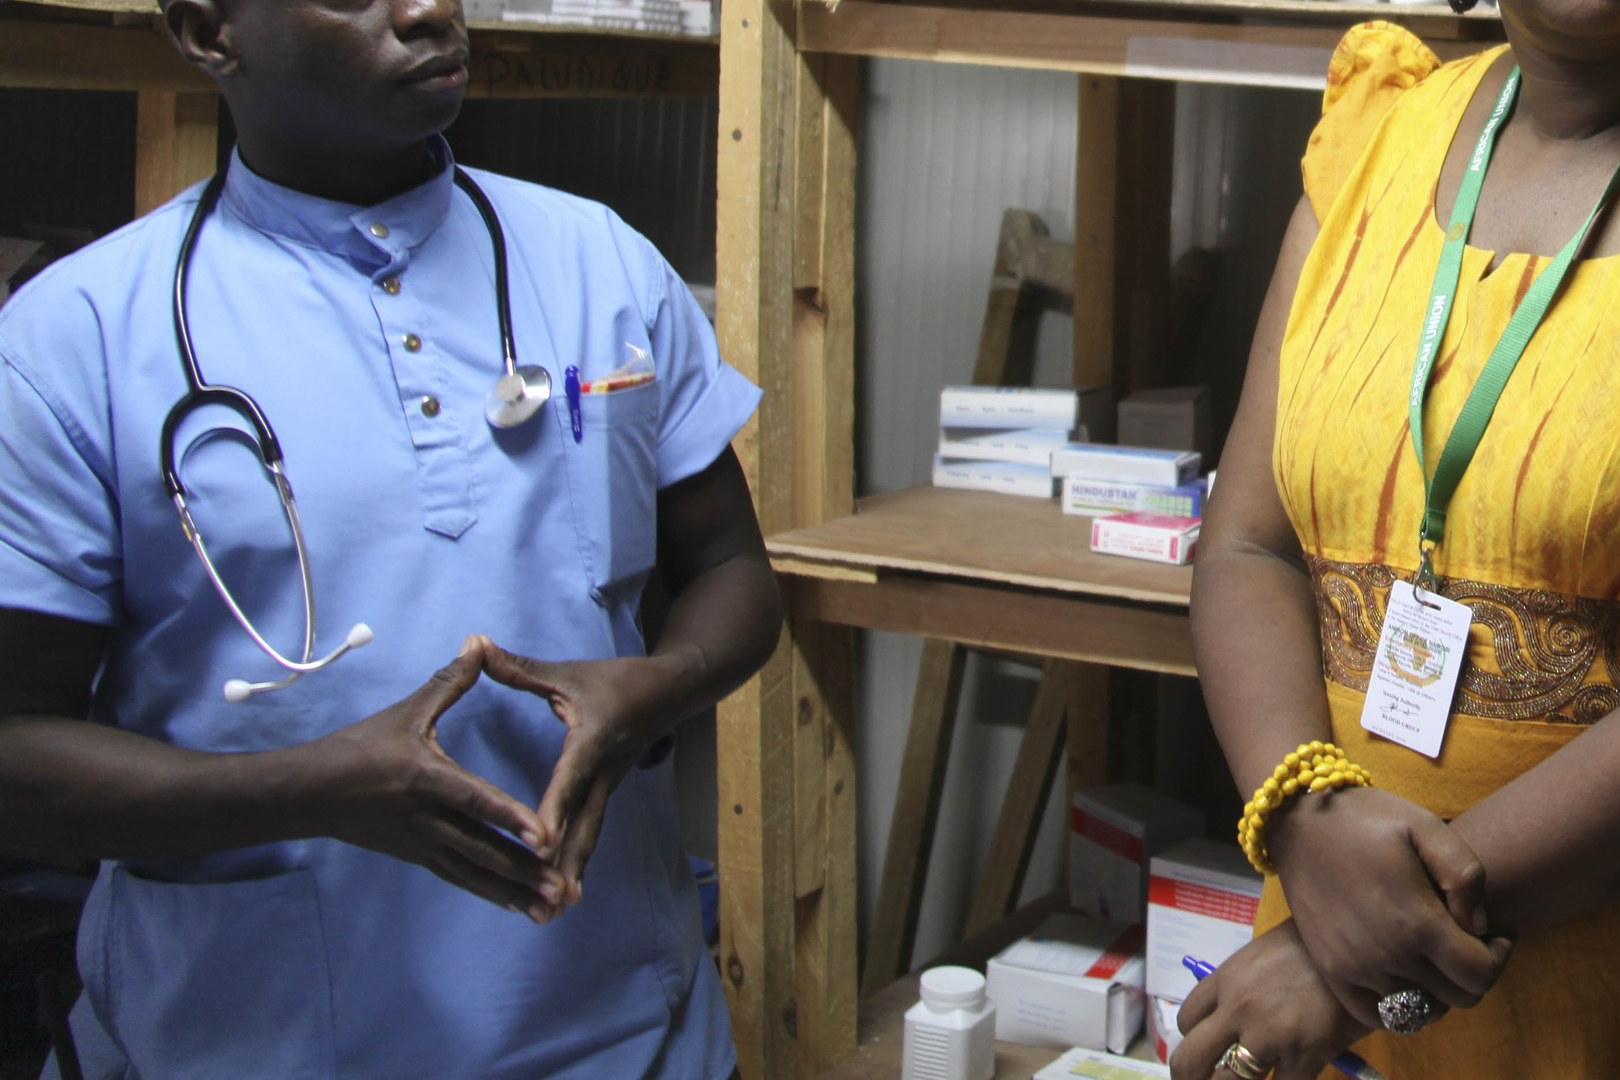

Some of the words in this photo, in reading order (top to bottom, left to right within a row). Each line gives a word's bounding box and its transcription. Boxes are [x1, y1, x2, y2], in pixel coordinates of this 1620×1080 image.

[1470, 116, 1500, 172] AFRICAN
[1493, 76, 1516, 118] UNION
[1411, 342, 1434, 406] AFRICAN
[1424, 294, 1447, 341] UNION
[1071, 484, 1138, 501] HINDUSTAN
[1400, 698, 1421, 711] Authority
